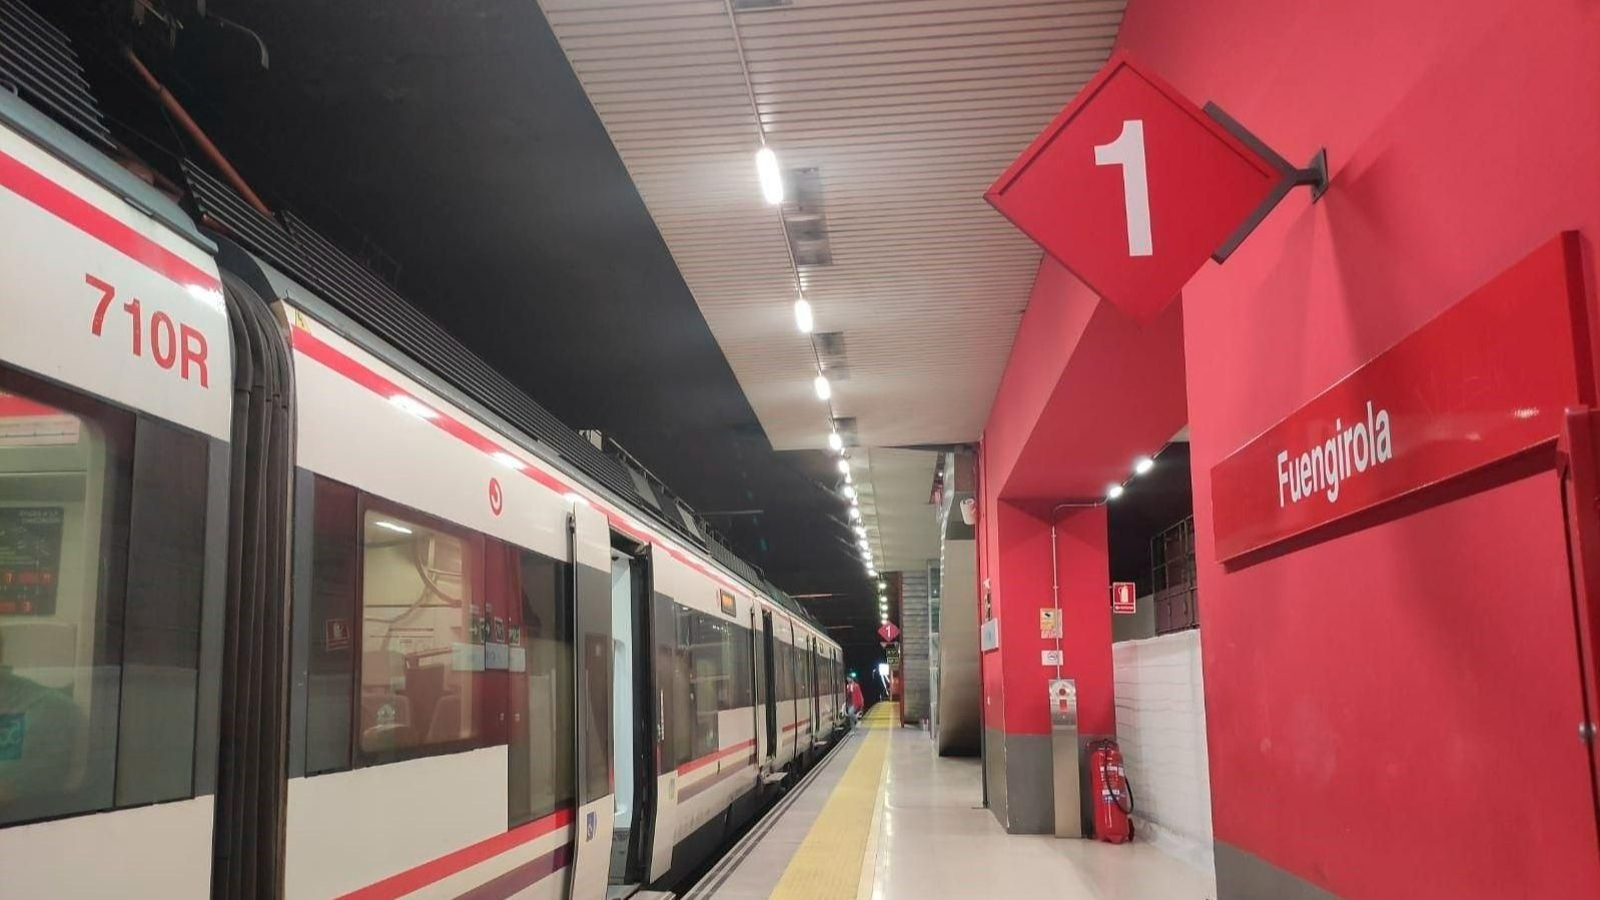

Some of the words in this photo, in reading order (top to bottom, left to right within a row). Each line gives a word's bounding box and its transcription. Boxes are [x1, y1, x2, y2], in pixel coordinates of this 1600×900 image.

[1094, 119, 1153, 257] 1
[85, 273, 209, 389] 710R
[1277, 400, 1393, 508] Fuengirola
